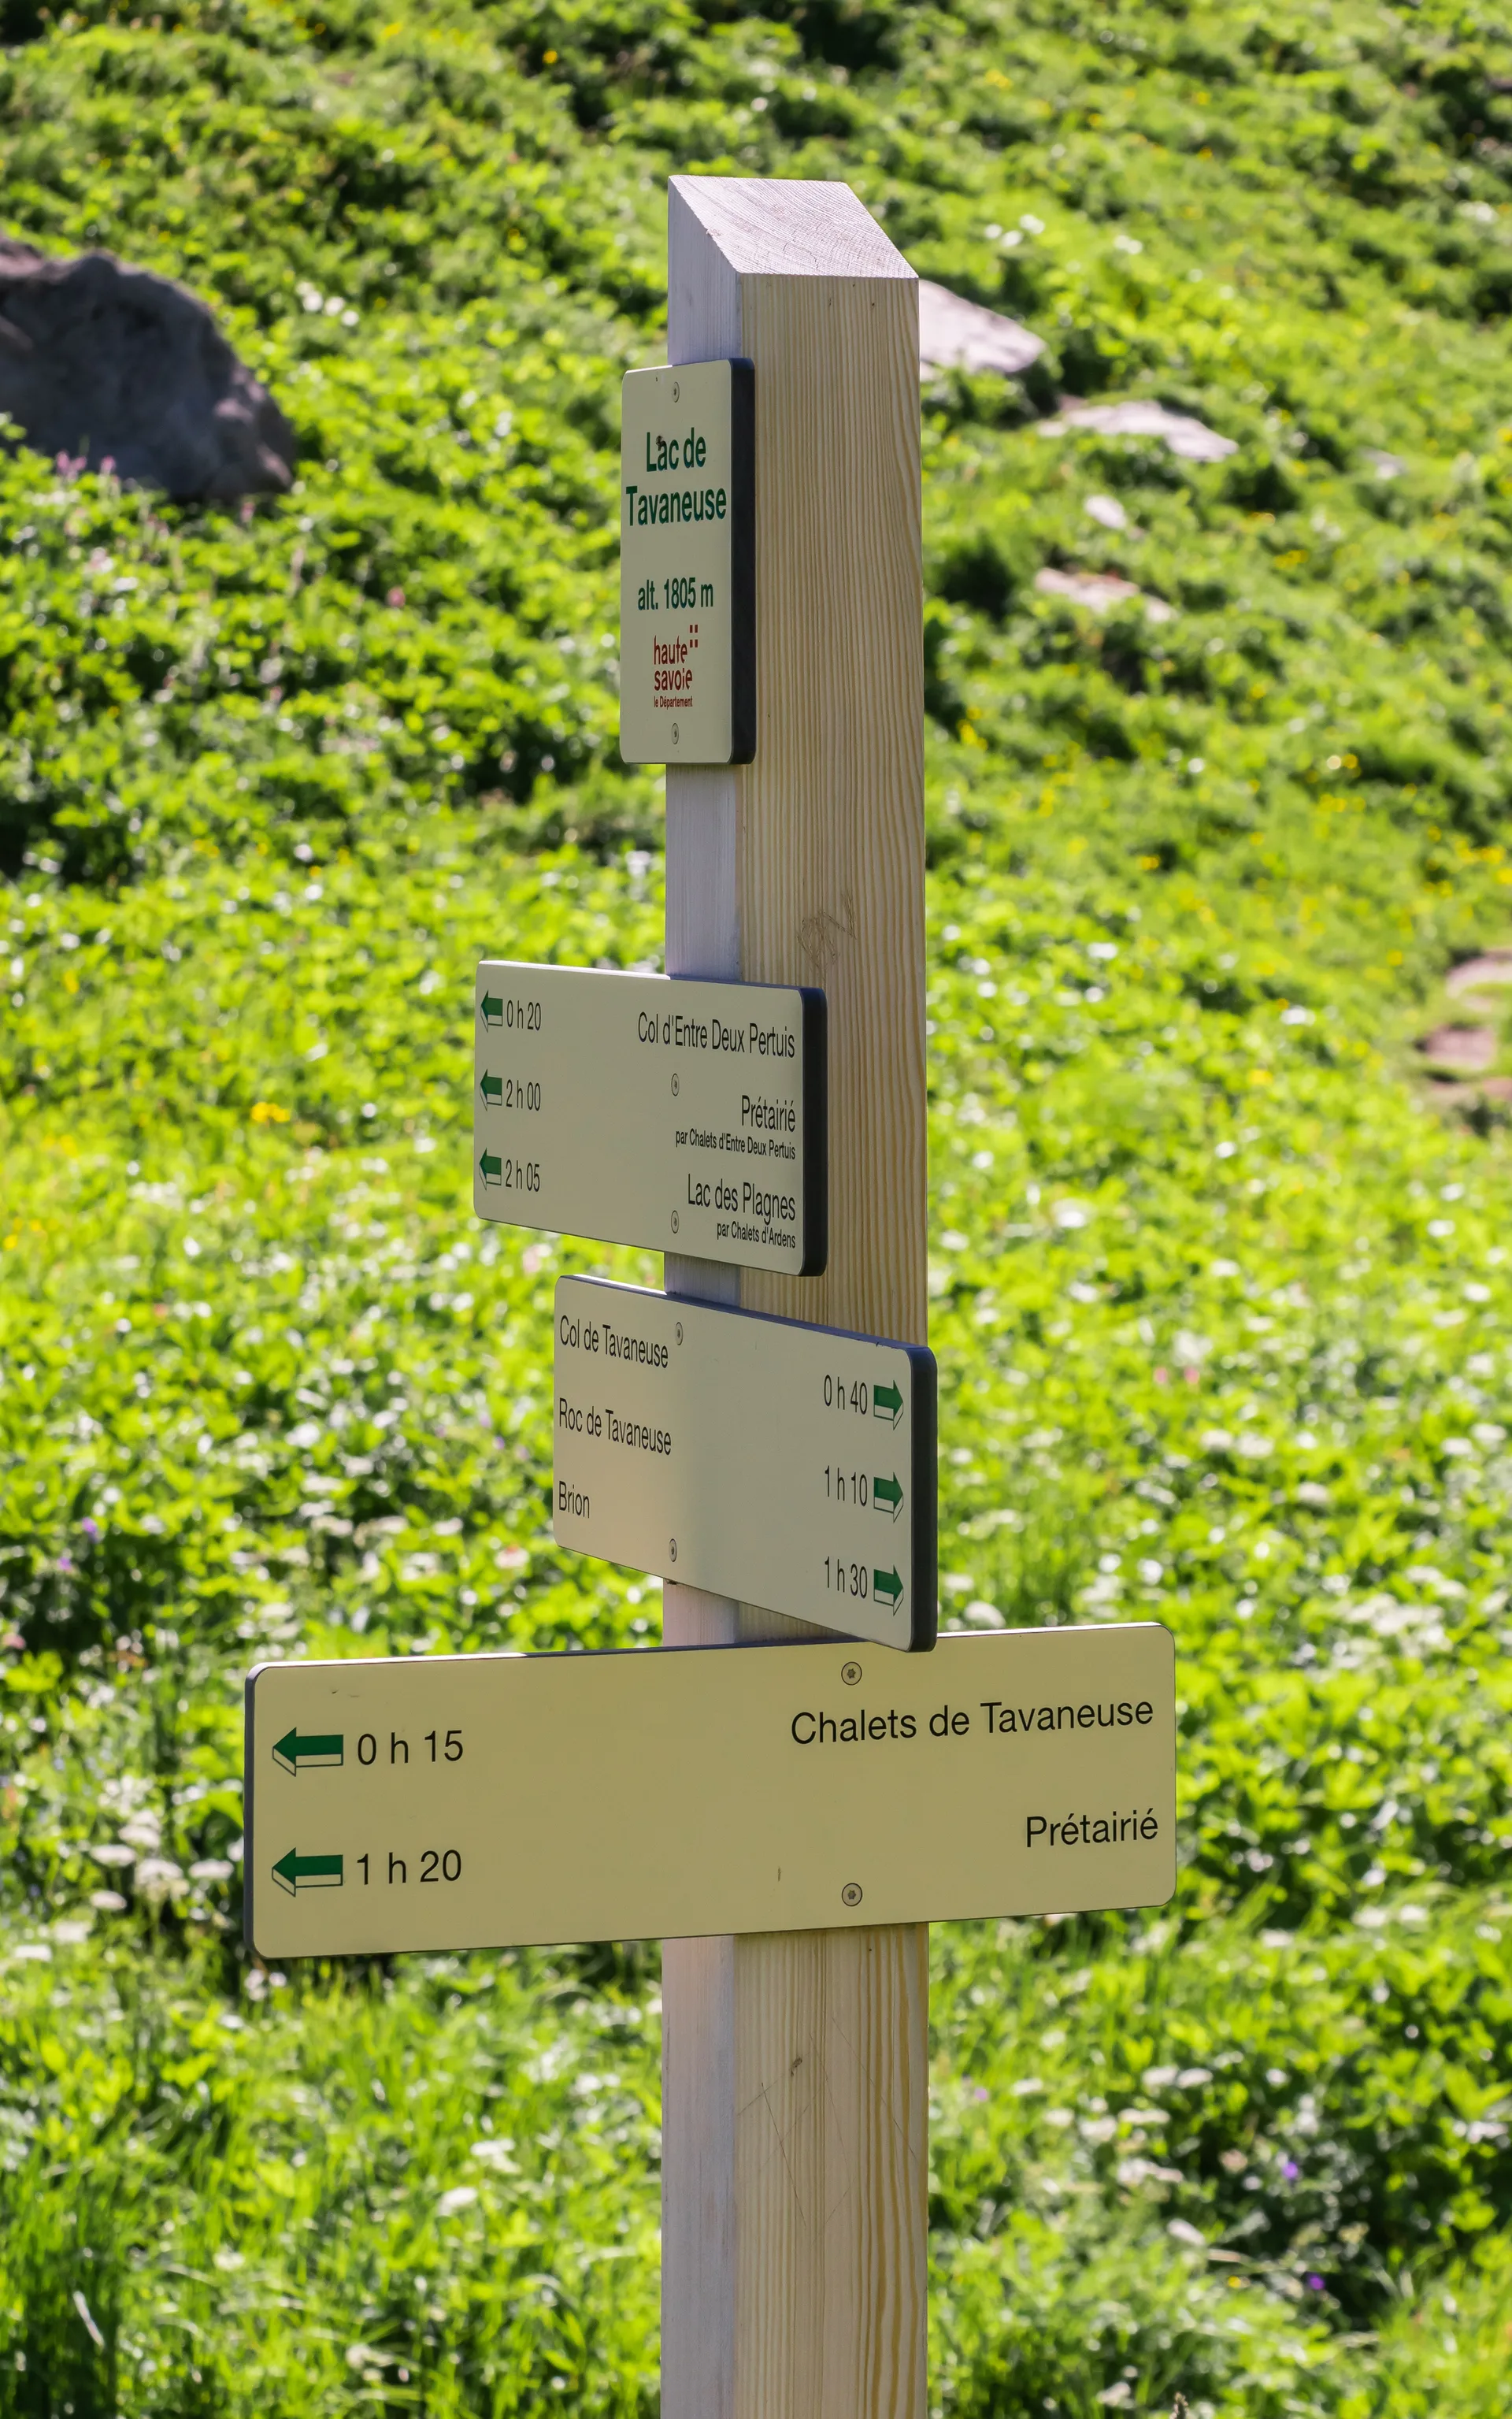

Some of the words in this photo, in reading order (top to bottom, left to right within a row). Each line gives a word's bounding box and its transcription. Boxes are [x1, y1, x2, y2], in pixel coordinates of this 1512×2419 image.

[647, 432, 680, 472] Lac
[683, 427, 706, 469] de
[626, 485, 727, 525] Tavaneuse
[638, 579, 658, 610] alt.
[664, 577, 696, 610] 1805
[700, 584, 713, 607] m
[654, 635, 687, 665] haute
[654, 668, 693, 691] savoie
[654, 696, 658, 707] le
[660, 696, 693, 710] Département
[506, 1000, 513, 1028] 0
[517, 1000, 524, 1028] h
[528, 1002, 542, 1030] 20
[638, 1012, 658, 1044] Col
[663, 1015, 707, 1048] d'Entre
[712, 1019, 745, 1052] Deux
[750, 1023, 795, 1058] Pertuis
[506, 1079, 513, 1107] 2
[517, 1081, 523, 1109] h
[527, 1082, 541, 1111] 00
[741, 1095, 795, 1132] Prétairié
[676, 1130, 687, 1148] par
[689, 1128, 717, 1148] Chalets
[718, 1133, 745, 1153] d'Entre
[747, 1137, 766, 1156] Deux
[769, 1140, 795, 1160] Pertuis
[506, 1159, 512, 1188] 2
[516, 1161, 522, 1189] h
[527, 1163, 540, 1192] 05
[688, 1174, 710, 1208] Lac
[715, 1178, 738, 1211] des
[743, 1182, 795, 1225] Plagnes
[717, 1222, 729, 1240] par
[731, 1220, 760, 1244] Chalets
[762, 1226, 795, 1248] d'Ardens
[560, 1315, 580, 1346] Col
[584, 1319, 598, 1351] de
[602, 1325, 669, 1368] Tavaneuse
[824, 1375, 832, 1407] 0
[837, 1376, 845, 1410] h
[850, 1382, 867, 1415] 40
[559, 1398, 583, 1433] Roc
[587, 1406, 602, 1437] de
[605, 1409, 672, 1456] Tavaneuse
[558, 1481, 590, 1519] Brion
[825, 1465, 829, 1497] 1
[837, 1467, 845, 1501] h
[850, 1472, 867, 1506] 10
[825, 1556, 829, 1588] 1
[837, 1559, 844, 1593] h
[850, 1564, 867, 1598] 30
[791, 1709, 917, 1745] Chalets
[929, 1705, 969, 1737] de
[980, 1701, 1153, 1734] Tavaneuse
[358, 1733, 376, 1765] 0
[391, 1732, 409, 1764] h
[424, 1730, 464, 1763] 15
[1026, 1808, 1158, 1848] Prétairié
[358, 1853, 369, 1885] 1
[389, 1852, 407, 1883] h
[420, 1849, 461, 1883] 20
